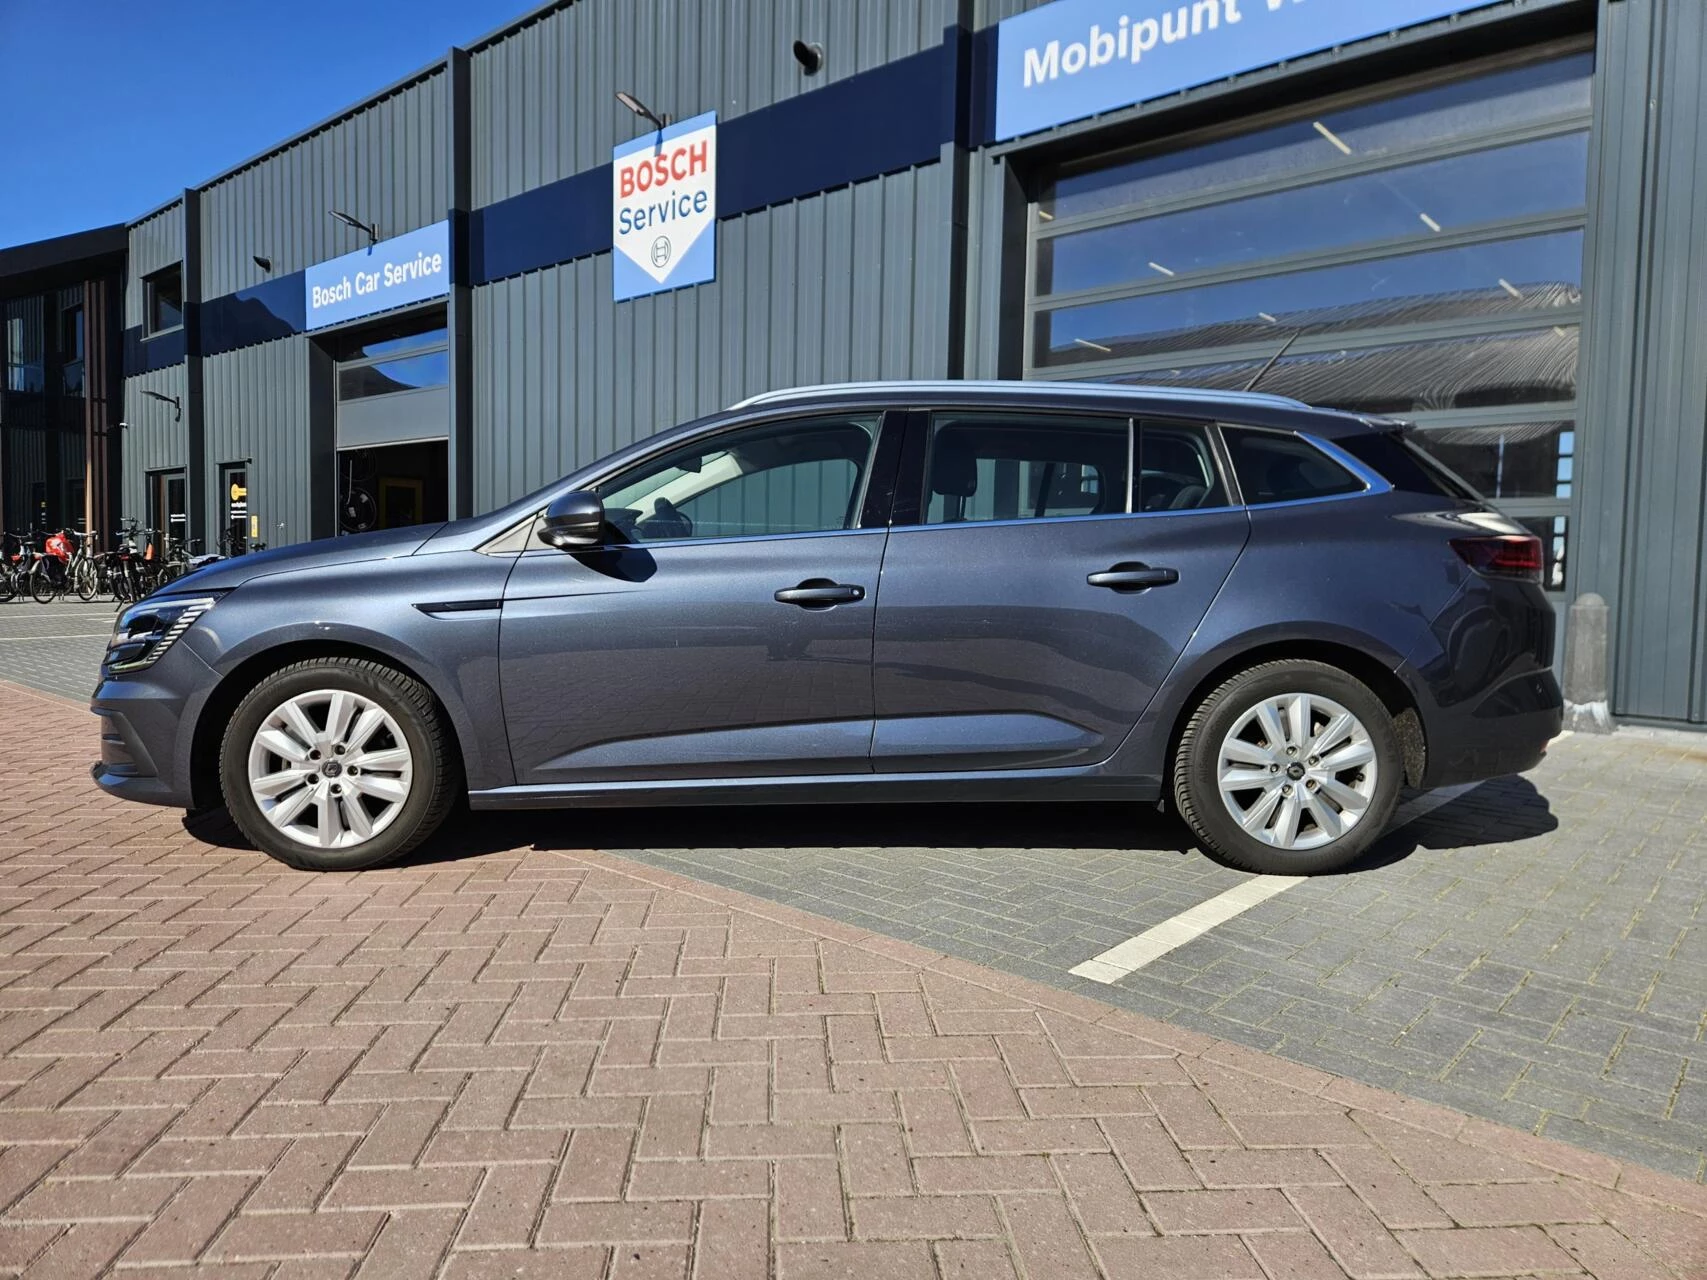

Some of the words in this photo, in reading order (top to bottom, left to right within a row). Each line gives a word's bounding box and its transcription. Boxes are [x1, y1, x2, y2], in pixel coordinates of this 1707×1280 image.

[1023, 0, 1242, 87] Mobipunt
[620, 140, 707, 198] BOSCH
[619, 190, 708, 235] Service
[312, 276, 351, 309] Bosch
[355, 271, 380, 295] Car
[384, 252, 442, 287] Service
